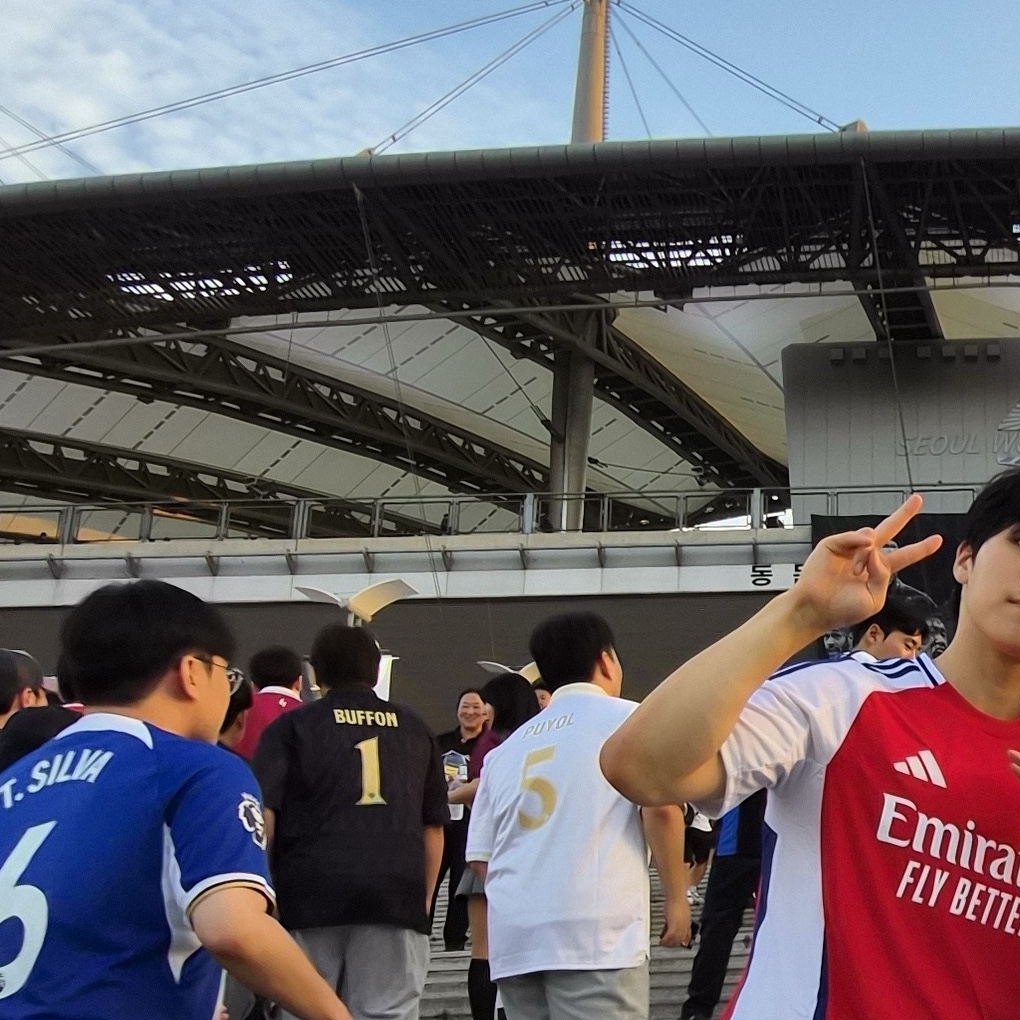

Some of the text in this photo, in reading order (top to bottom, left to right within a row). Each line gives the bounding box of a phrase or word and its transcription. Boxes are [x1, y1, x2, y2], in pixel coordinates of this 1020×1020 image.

[896, 433, 980, 457] SEOUL
[751, 565, 773, 586] 동
[333, 708, 399, 728] BUFFON
[523, 713, 574, 739] PUYOL
[0, 748, 115, 808] T. SILVA
[354, 736, 388, 806] 1
[517, 744, 557, 831] 5
[895, 860, 950, 908] FLY
